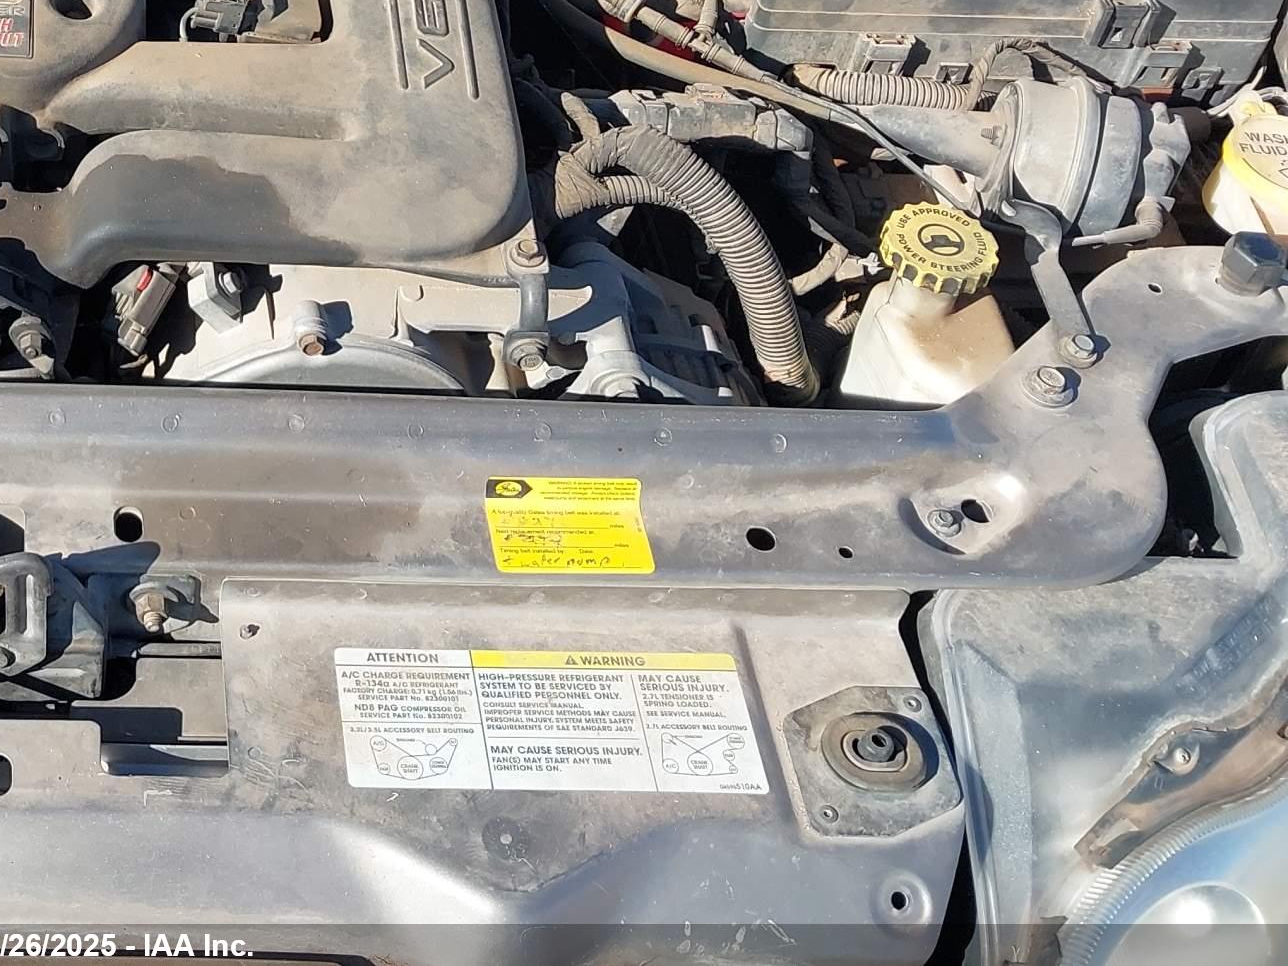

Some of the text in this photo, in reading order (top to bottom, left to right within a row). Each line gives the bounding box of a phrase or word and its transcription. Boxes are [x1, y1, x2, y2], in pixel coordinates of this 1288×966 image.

[1239, 143, 1287, 155] FLUID
[897, 208, 970, 229] USE APPROVED
[896, 232, 987, 272] POWER STEERING FLUID
[367, 652, 439, 663] ATTENTION
[580, 656, 645, 666] WARNING
[341, 671, 360, 679] A/C
[406, 672, 470, 680] REQUIREMENT
[479, 673, 624, 683] HIGH-PRESSURE REFRIGERANT
[666, 675, 701, 683] CAUSE
[480, 682, 516, 690] SYSTEM
[549, 683, 597, 691] SERVICED
[640, 683, 730, 692] SERIOUS INJURY.
[481, 691, 531, 699] QUALIFIED
[535, 691, 592, 700] PERSONNEL
[490, 746, 643, 755] MAY CAUSE SERIOUS INJURY.
